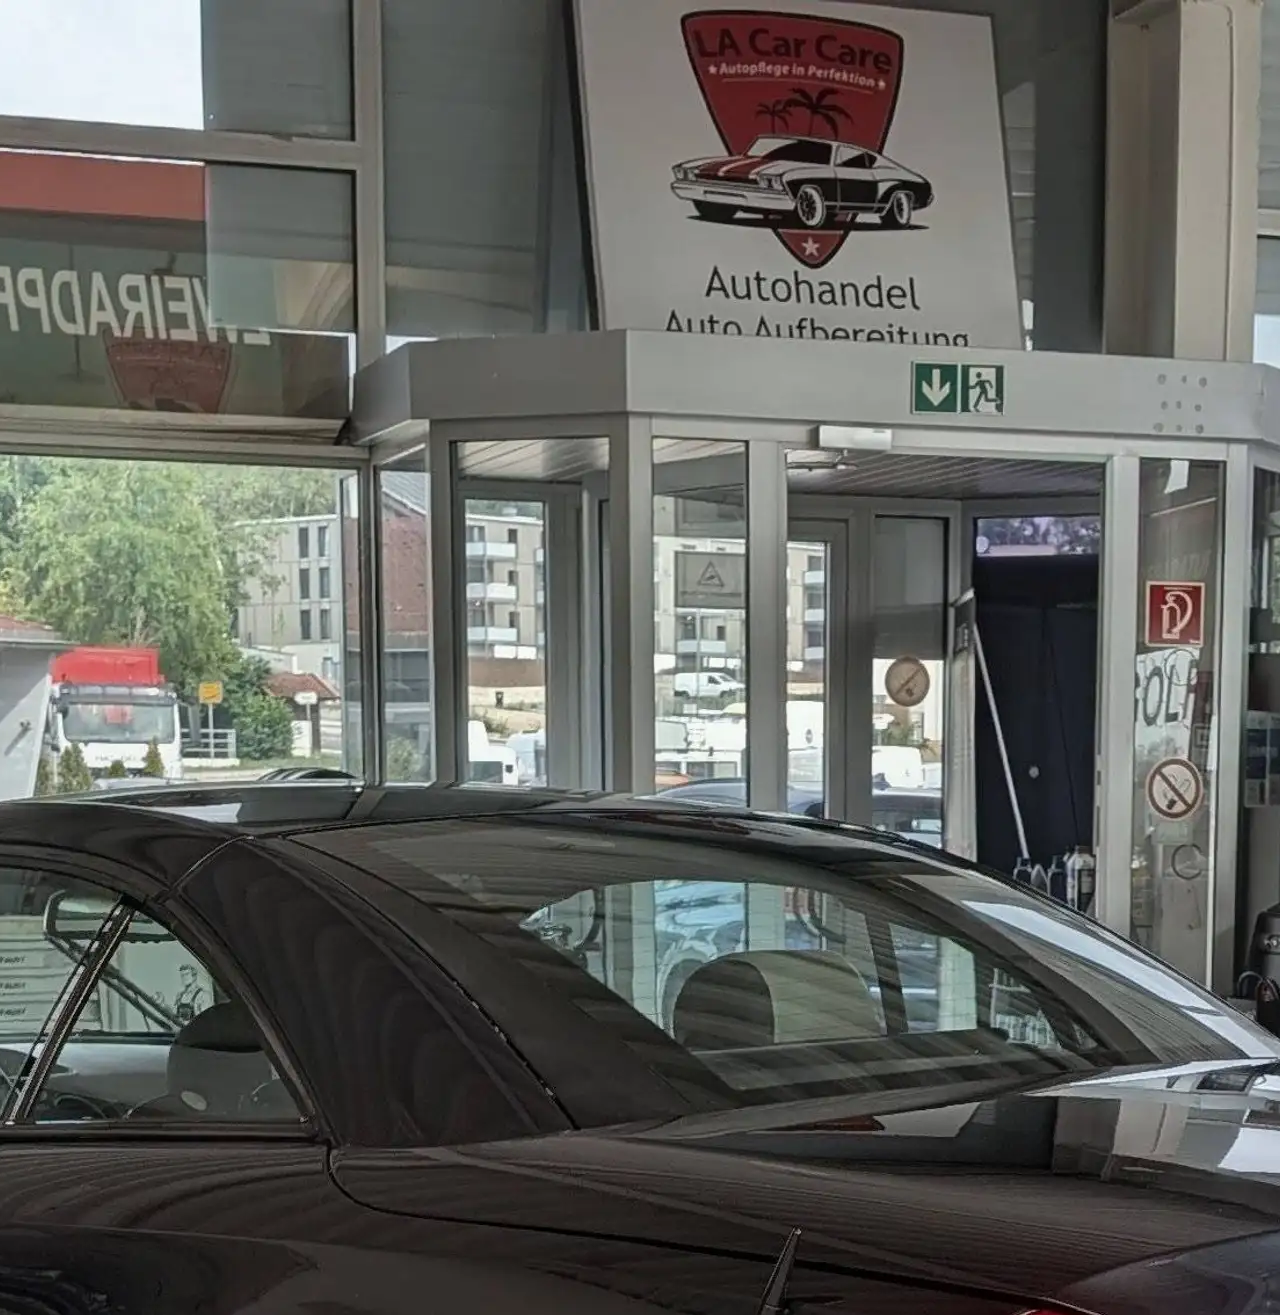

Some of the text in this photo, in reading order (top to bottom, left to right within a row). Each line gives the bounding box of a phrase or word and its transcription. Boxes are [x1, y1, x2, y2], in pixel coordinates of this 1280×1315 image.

[693, 28, 892, 75] LA Car Care
[719, 61, 876, 89] Autopflege in Perfektion
[705, 265, 920, 311] Autohandel
